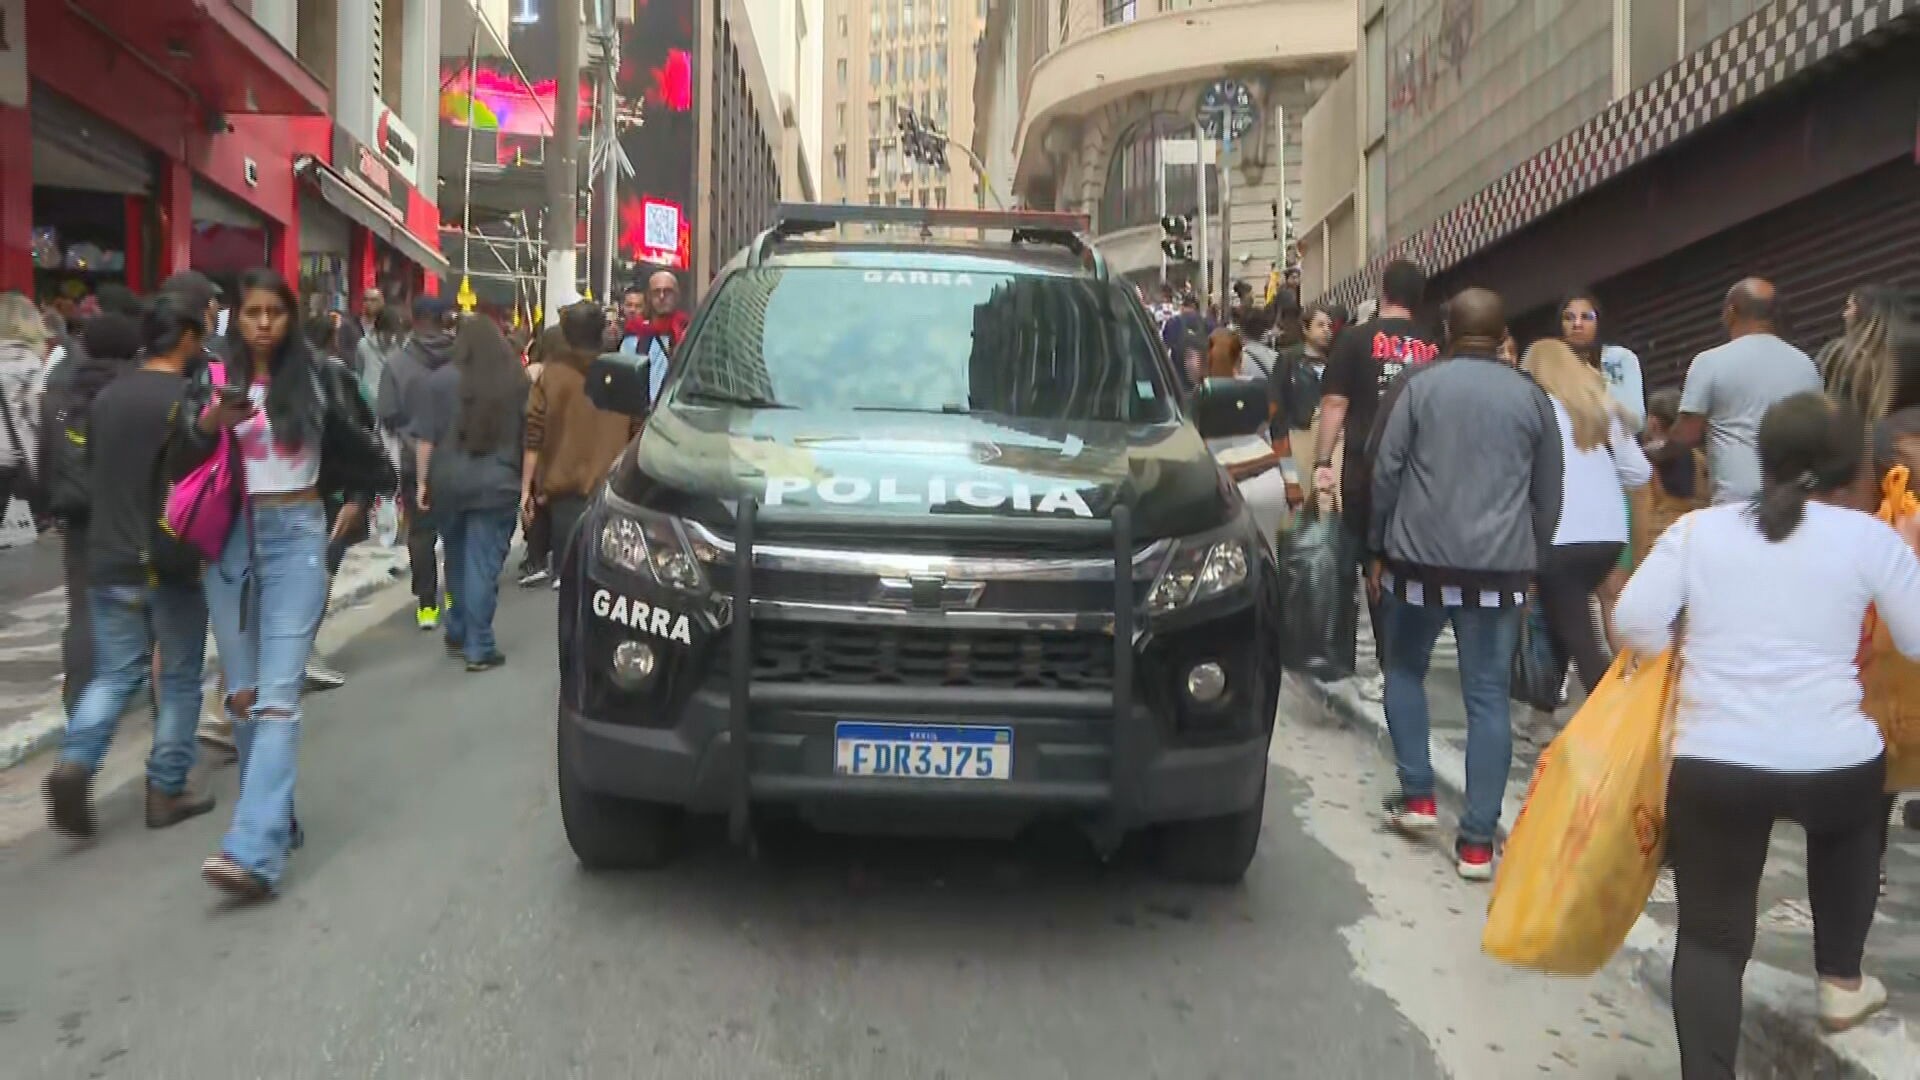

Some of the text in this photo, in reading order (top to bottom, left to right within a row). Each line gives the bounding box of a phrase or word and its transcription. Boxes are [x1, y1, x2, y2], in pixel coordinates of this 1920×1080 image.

[864, 270, 973, 285] GARRA
[592, 589, 691, 645] GARRA
[852, 742, 993, 777] FDR3J75
